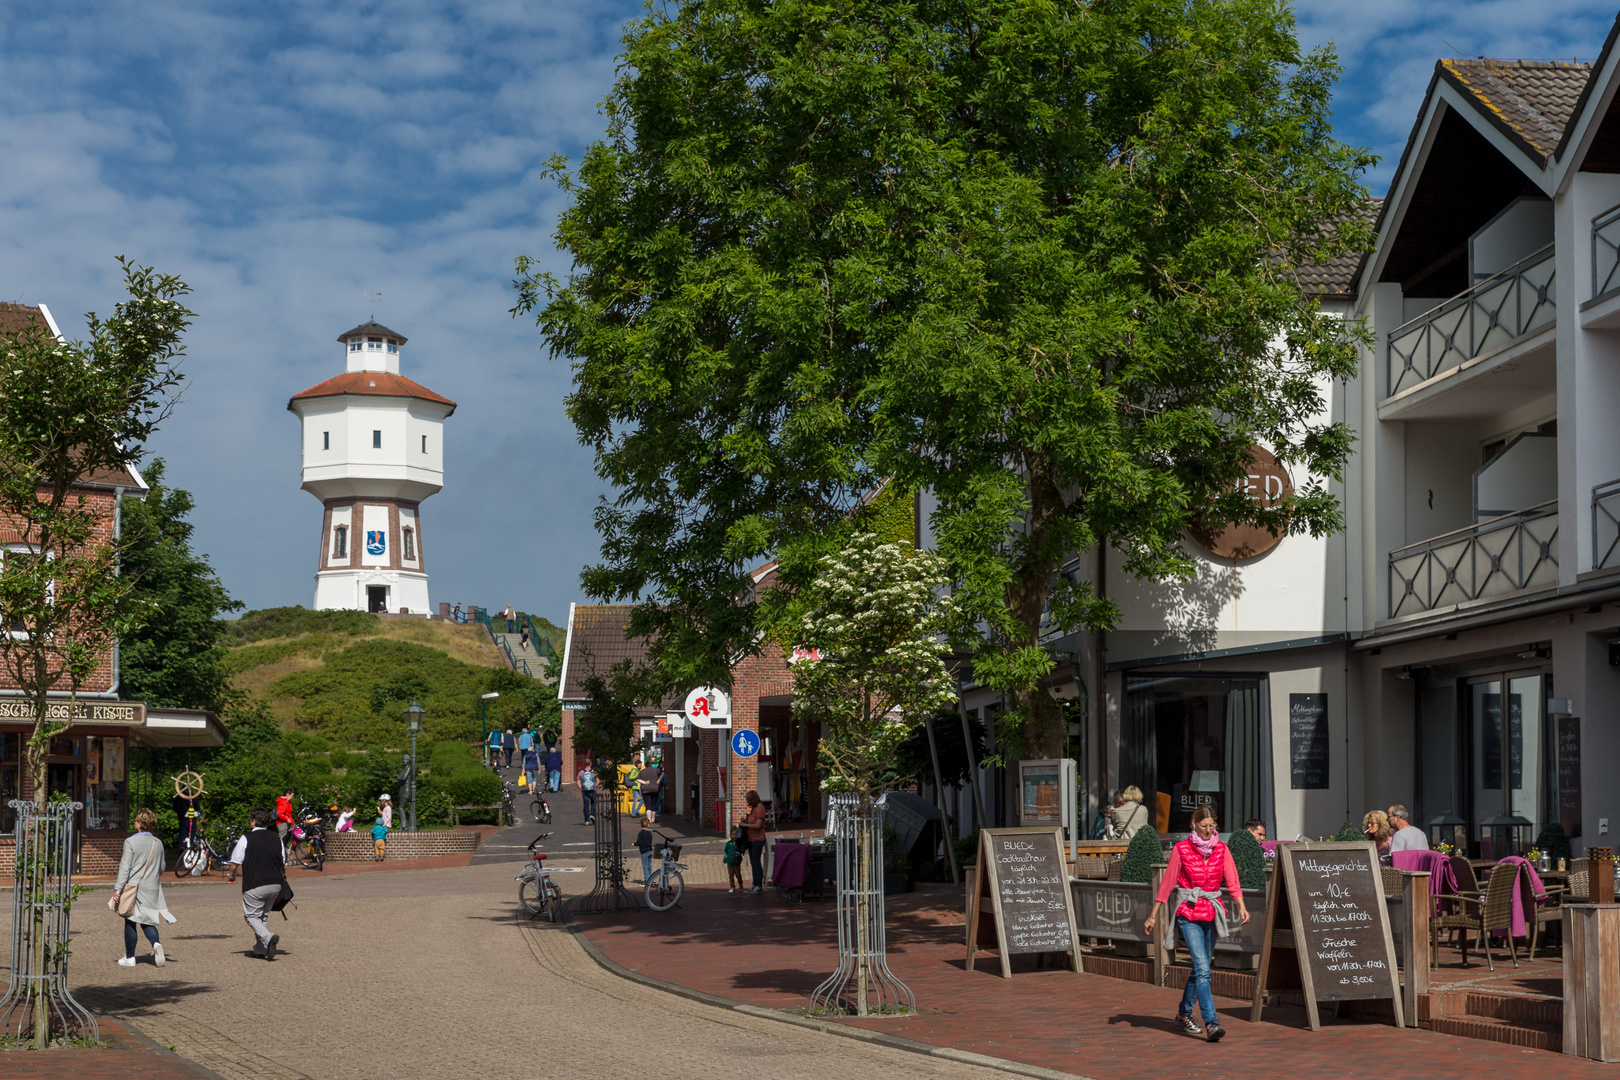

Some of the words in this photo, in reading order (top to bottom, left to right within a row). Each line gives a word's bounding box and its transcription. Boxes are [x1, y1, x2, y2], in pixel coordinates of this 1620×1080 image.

[93, 706, 134, 720] KISTE
[1181, 794, 1212, 806] BLIED
[996, 852, 1046, 863] Cocktailhour
[1010, 864, 1038, 876] täglich
[1298, 859, 1369, 878] Mittagsgerichte
[1096, 890, 1131, 915] BLIED
[1313, 900, 1340, 914] täglich
[1322, 938, 1358, 948] Frische
[1316, 948, 1354, 962] Waffeln
[1352, 975, 1374, 986] 3,50€
